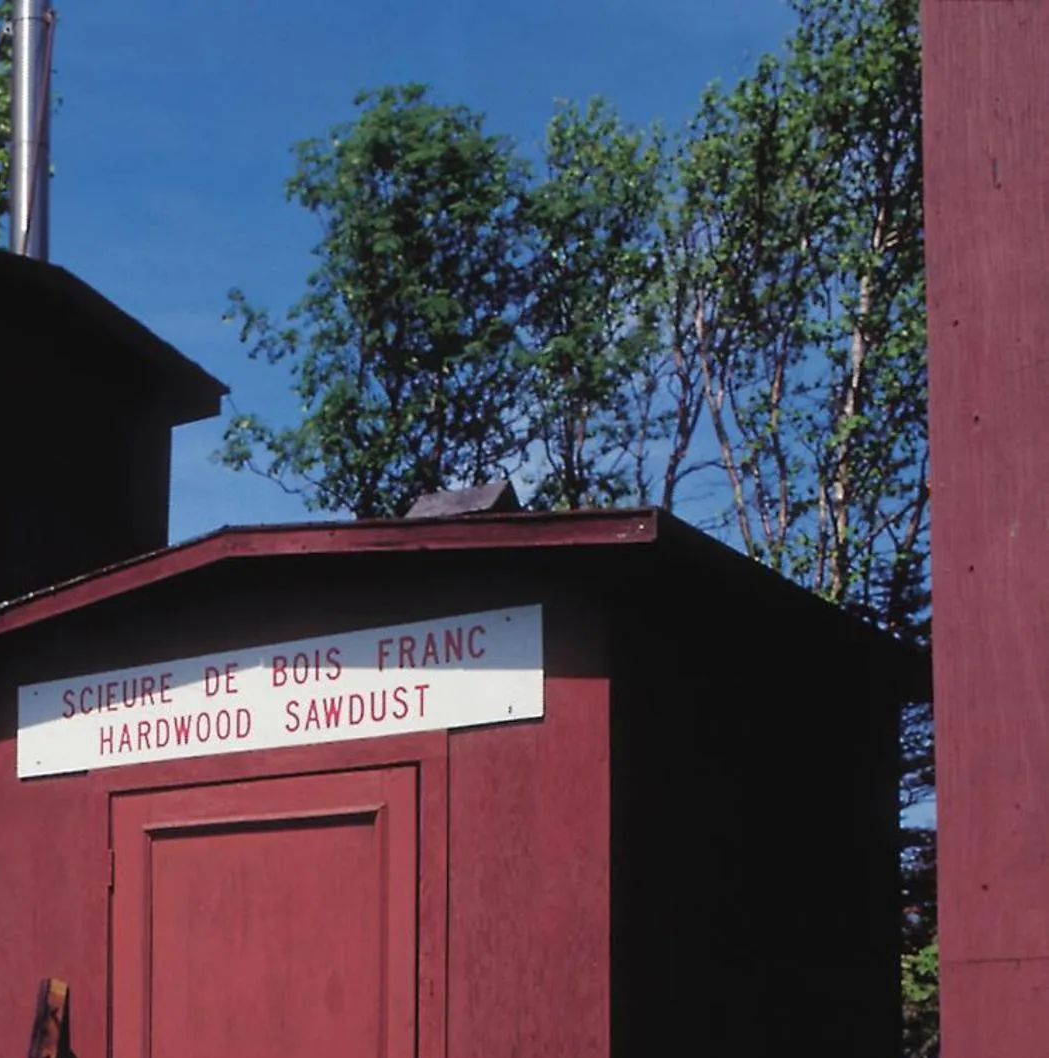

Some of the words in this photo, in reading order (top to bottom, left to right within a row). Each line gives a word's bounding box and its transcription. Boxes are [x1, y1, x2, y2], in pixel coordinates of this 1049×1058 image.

[61, 672, 173, 719] SCIEURE
[205, 662, 238, 697] DE
[271, 647, 342, 688] BOIS
[377, 625, 486, 671] FRANC
[99, 708, 252, 755] HARDWOOD
[285, 683, 430, 733] SAWDUST
